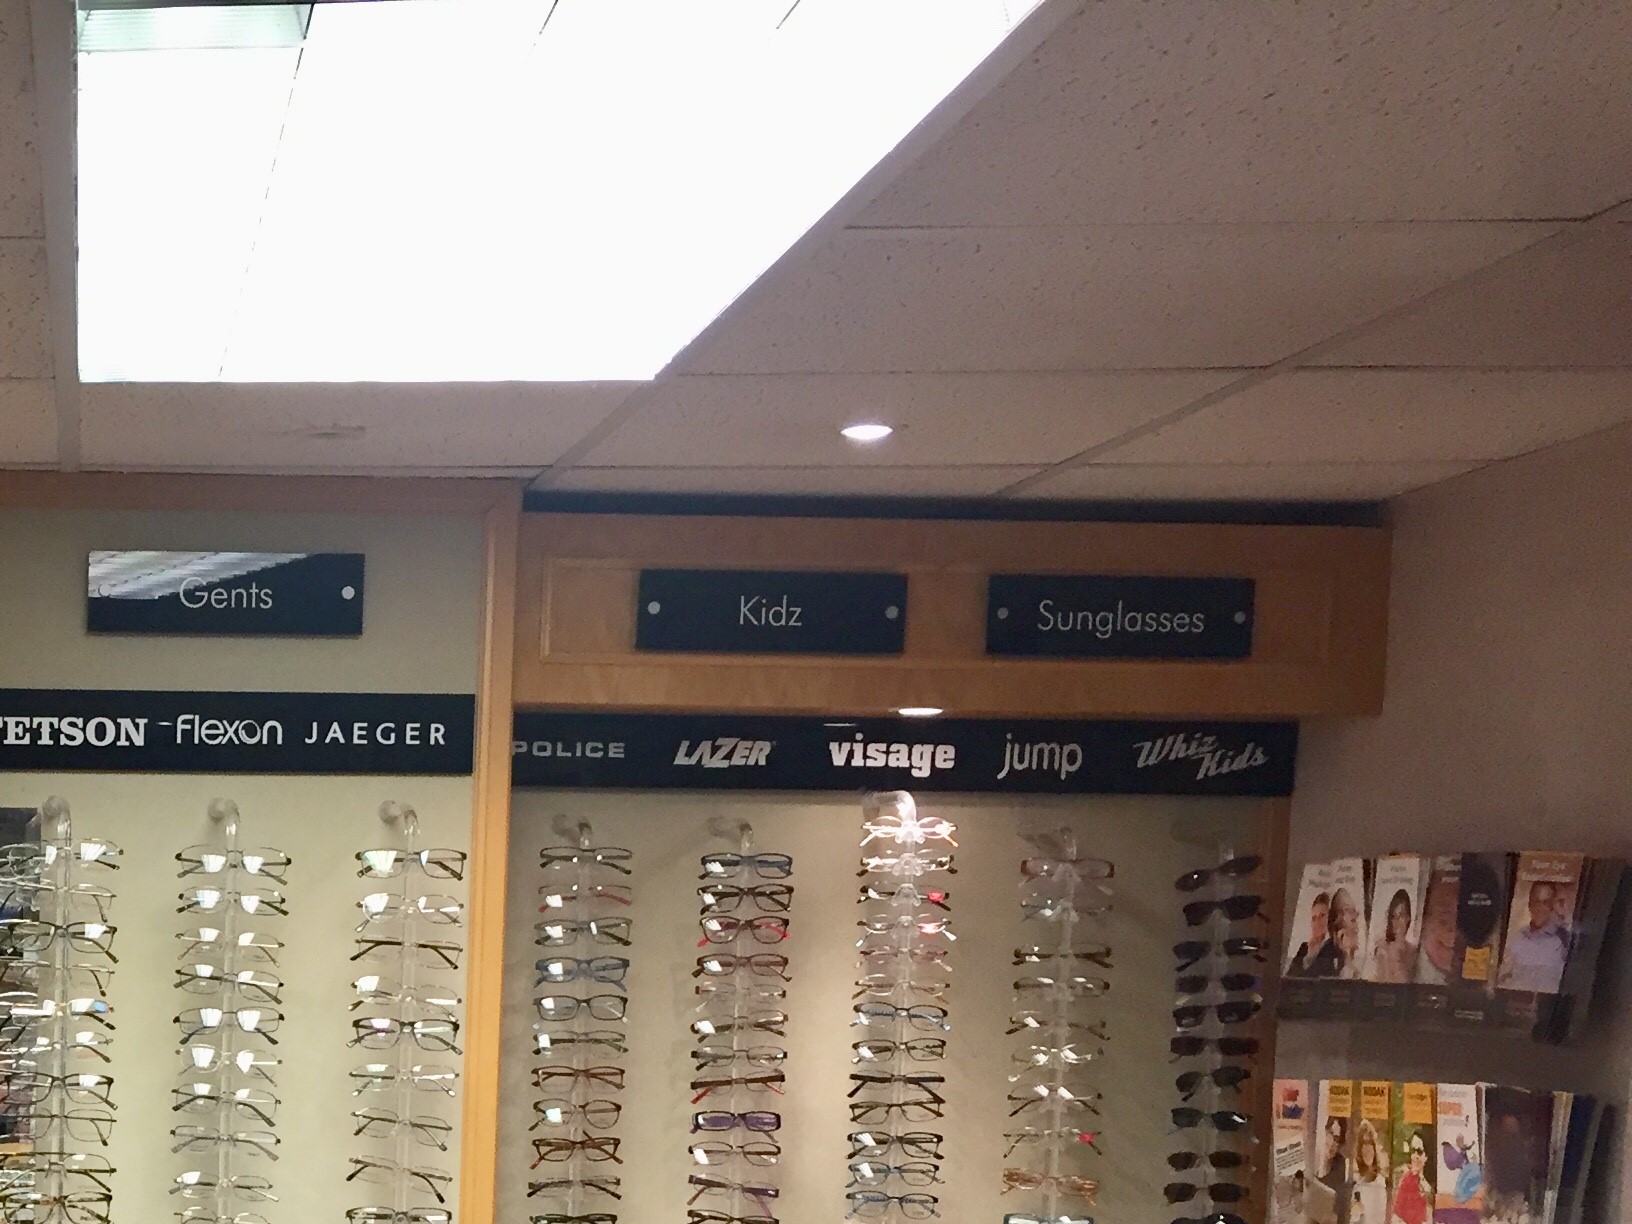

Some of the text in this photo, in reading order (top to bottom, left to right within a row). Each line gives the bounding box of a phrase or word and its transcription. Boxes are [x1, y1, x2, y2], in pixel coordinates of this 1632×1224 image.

[179, 577, 274, 610] Gents
[739, 595, 802, 627] Kidz
[1037, 599, 1205, 639] Sunglasses
[305, 722, 446, 746] JAEGER
[511, 740, 625, 759] POLICE
[1133, 733, 1218, 768] Whiz
[673, 737, 773, 768] LAZER
[829, 732, 956, 778] visage
[996, 732, 1083, 780] jump
[1192, 742, 1268, 780] Kids
